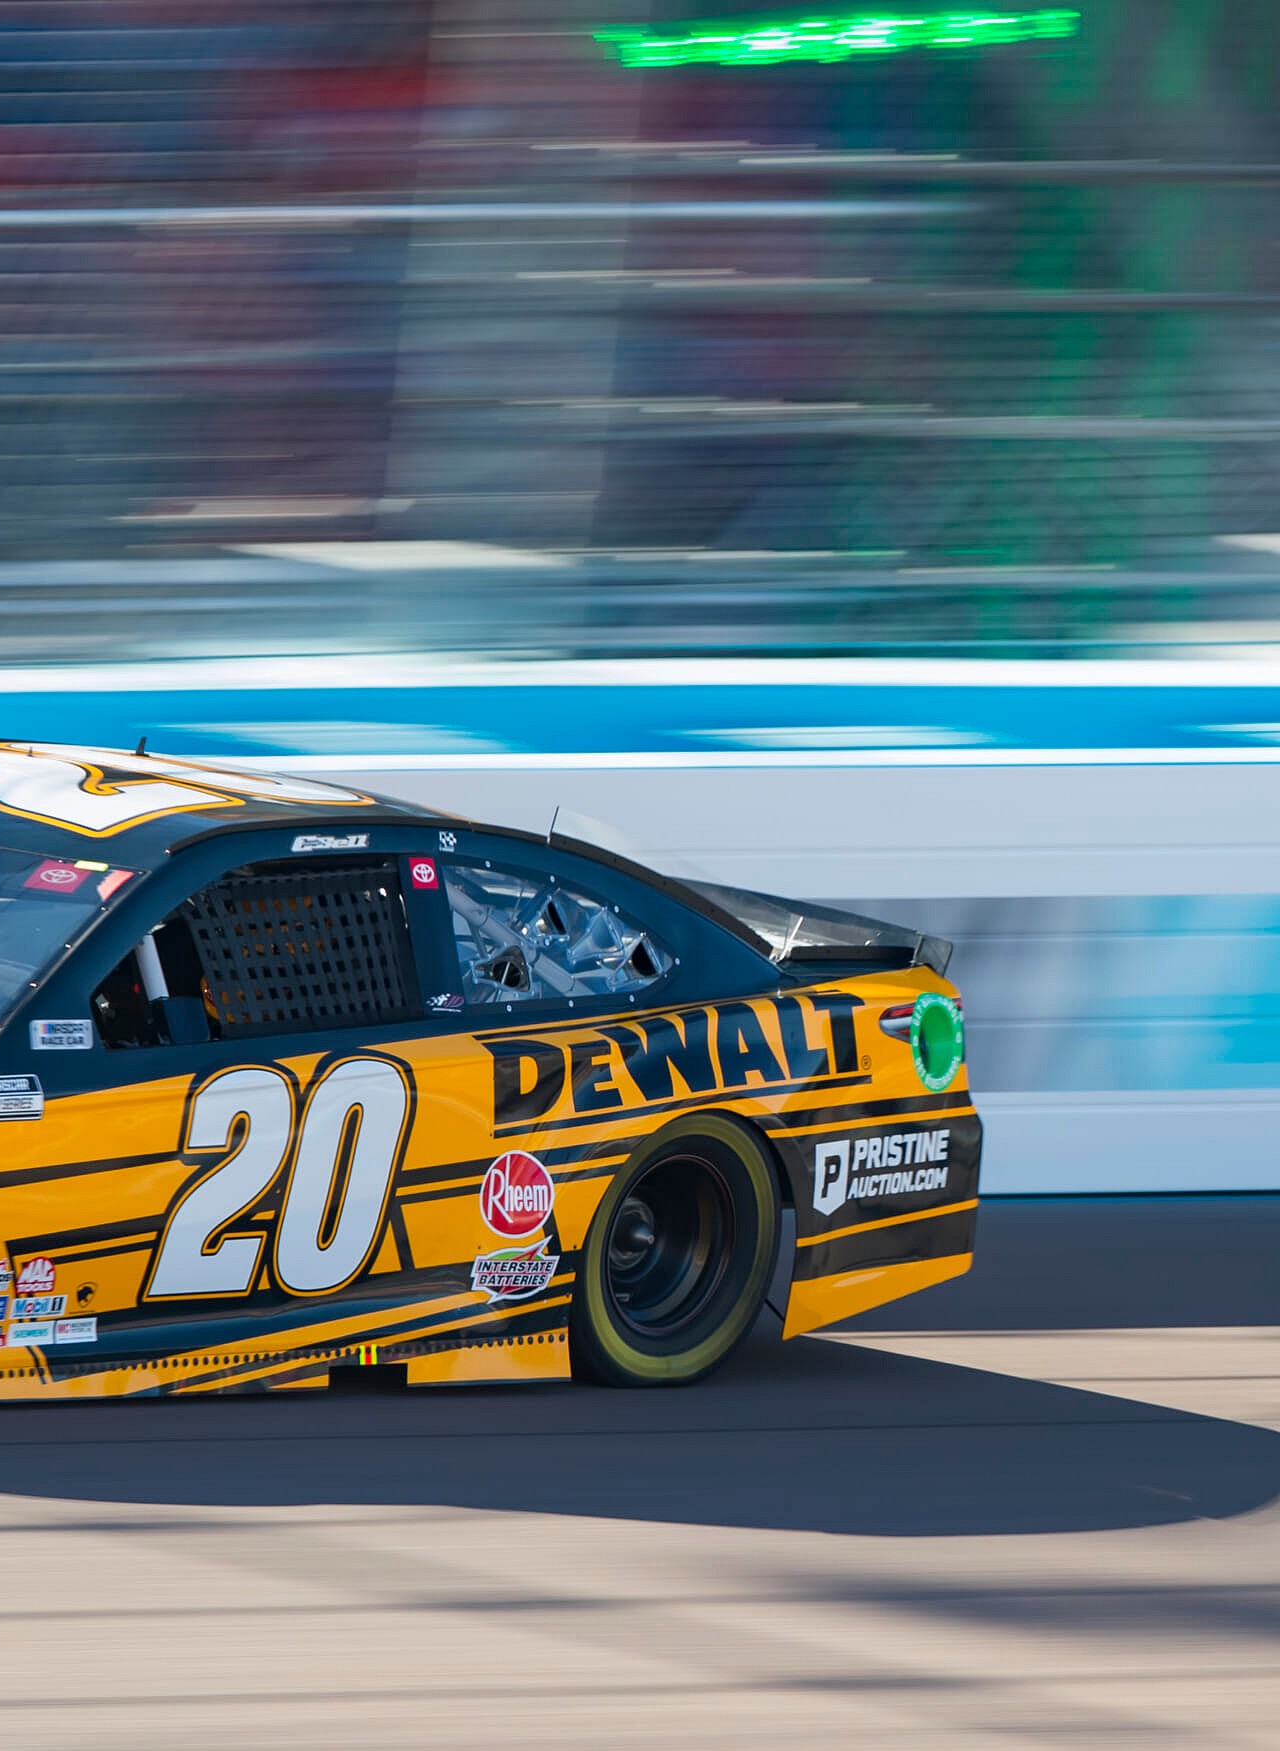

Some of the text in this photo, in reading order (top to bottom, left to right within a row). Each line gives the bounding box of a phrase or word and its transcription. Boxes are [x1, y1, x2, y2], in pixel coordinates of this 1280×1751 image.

[482, 991, 866, 1125] DEWALT
[851, 1129, 951, 1172] PRISTINE
[144, 1056, 412, 1300] 20
[487, 1154, 549, 1224] Rheem
[847, 1167, 949, 1200] AUCTION.COM
[477, 1259, 553, 1273] INTERSTATE
[478, 1273, 546, 1286] BATTERIES
